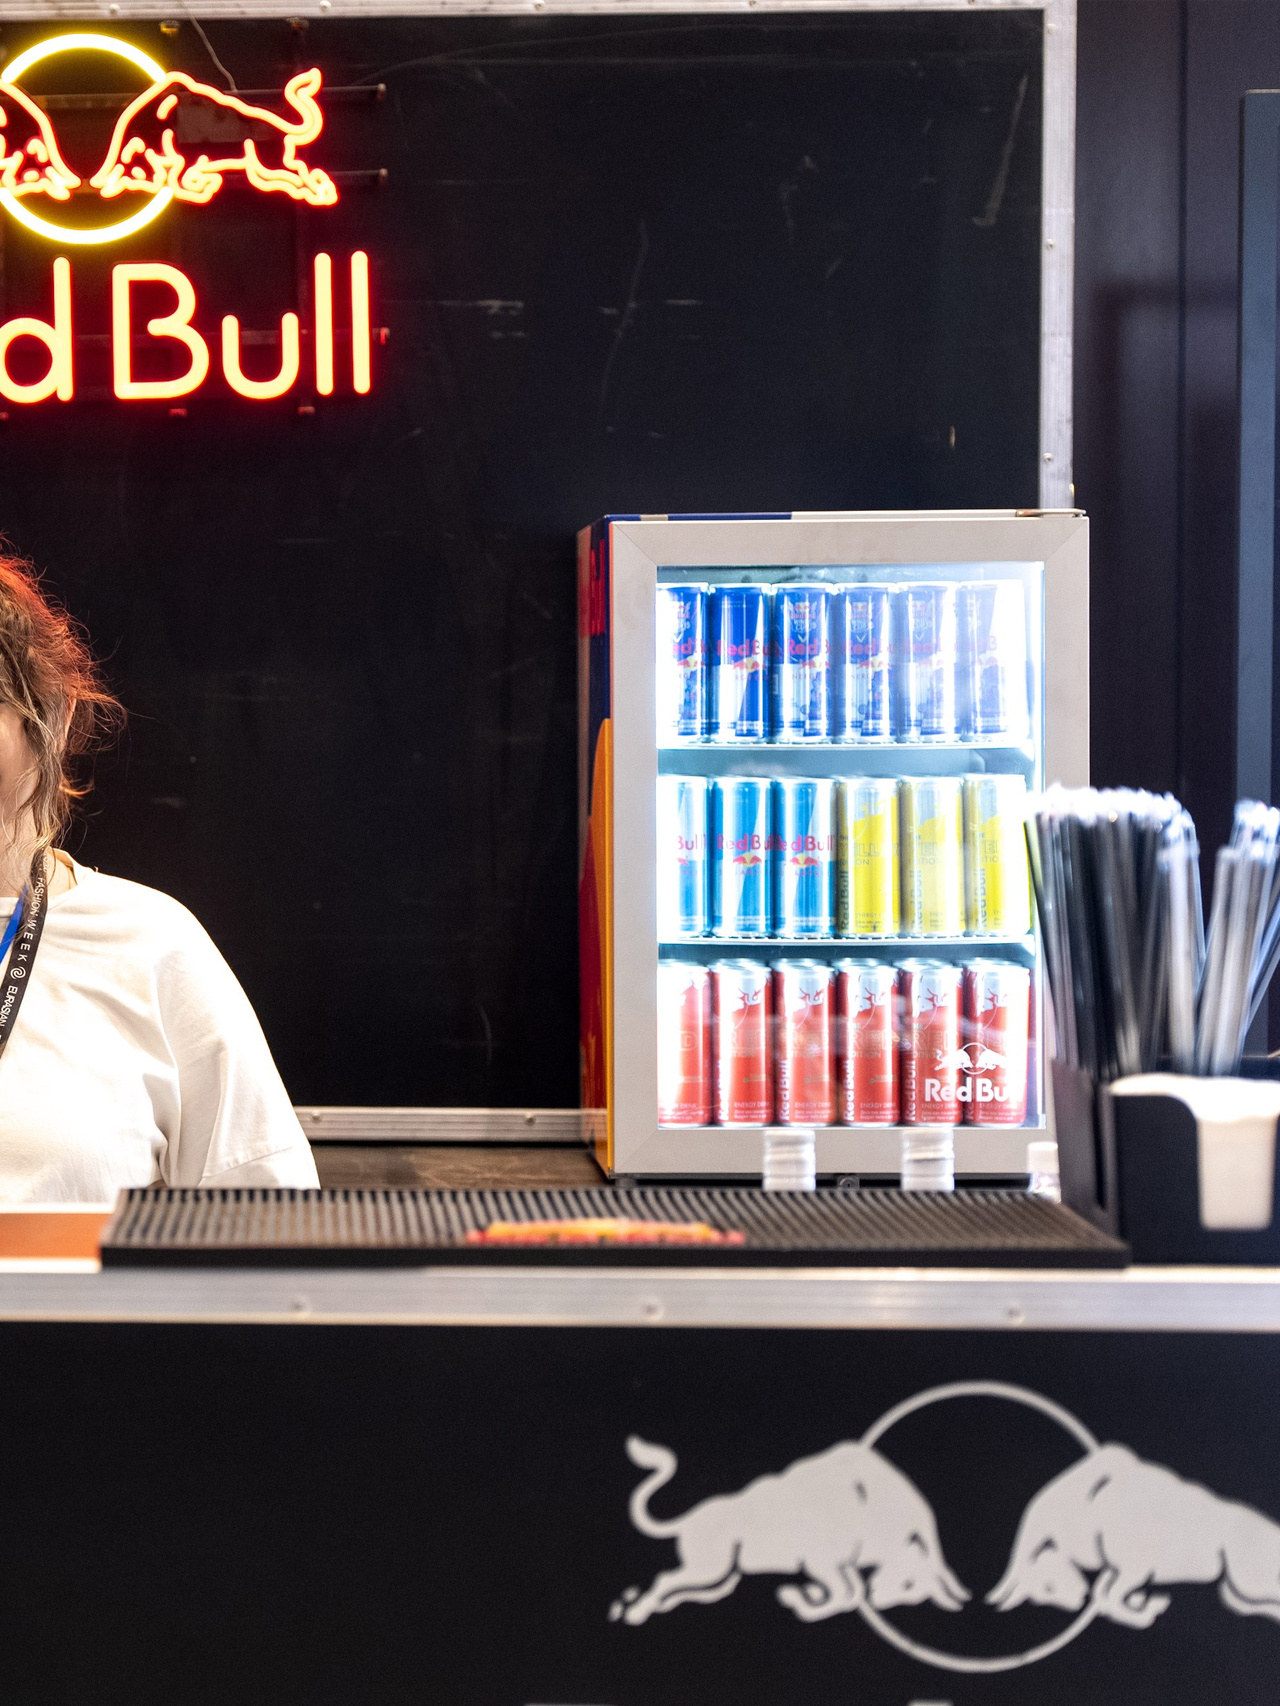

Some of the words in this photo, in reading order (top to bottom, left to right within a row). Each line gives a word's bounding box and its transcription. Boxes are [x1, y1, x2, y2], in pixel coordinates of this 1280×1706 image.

[112, 250, 370, 399] Bull
[29, 877, 46, 917] FASHION
[17, 920, 38, 962] WEEK
[925, 1077, 972, 1102] Red
